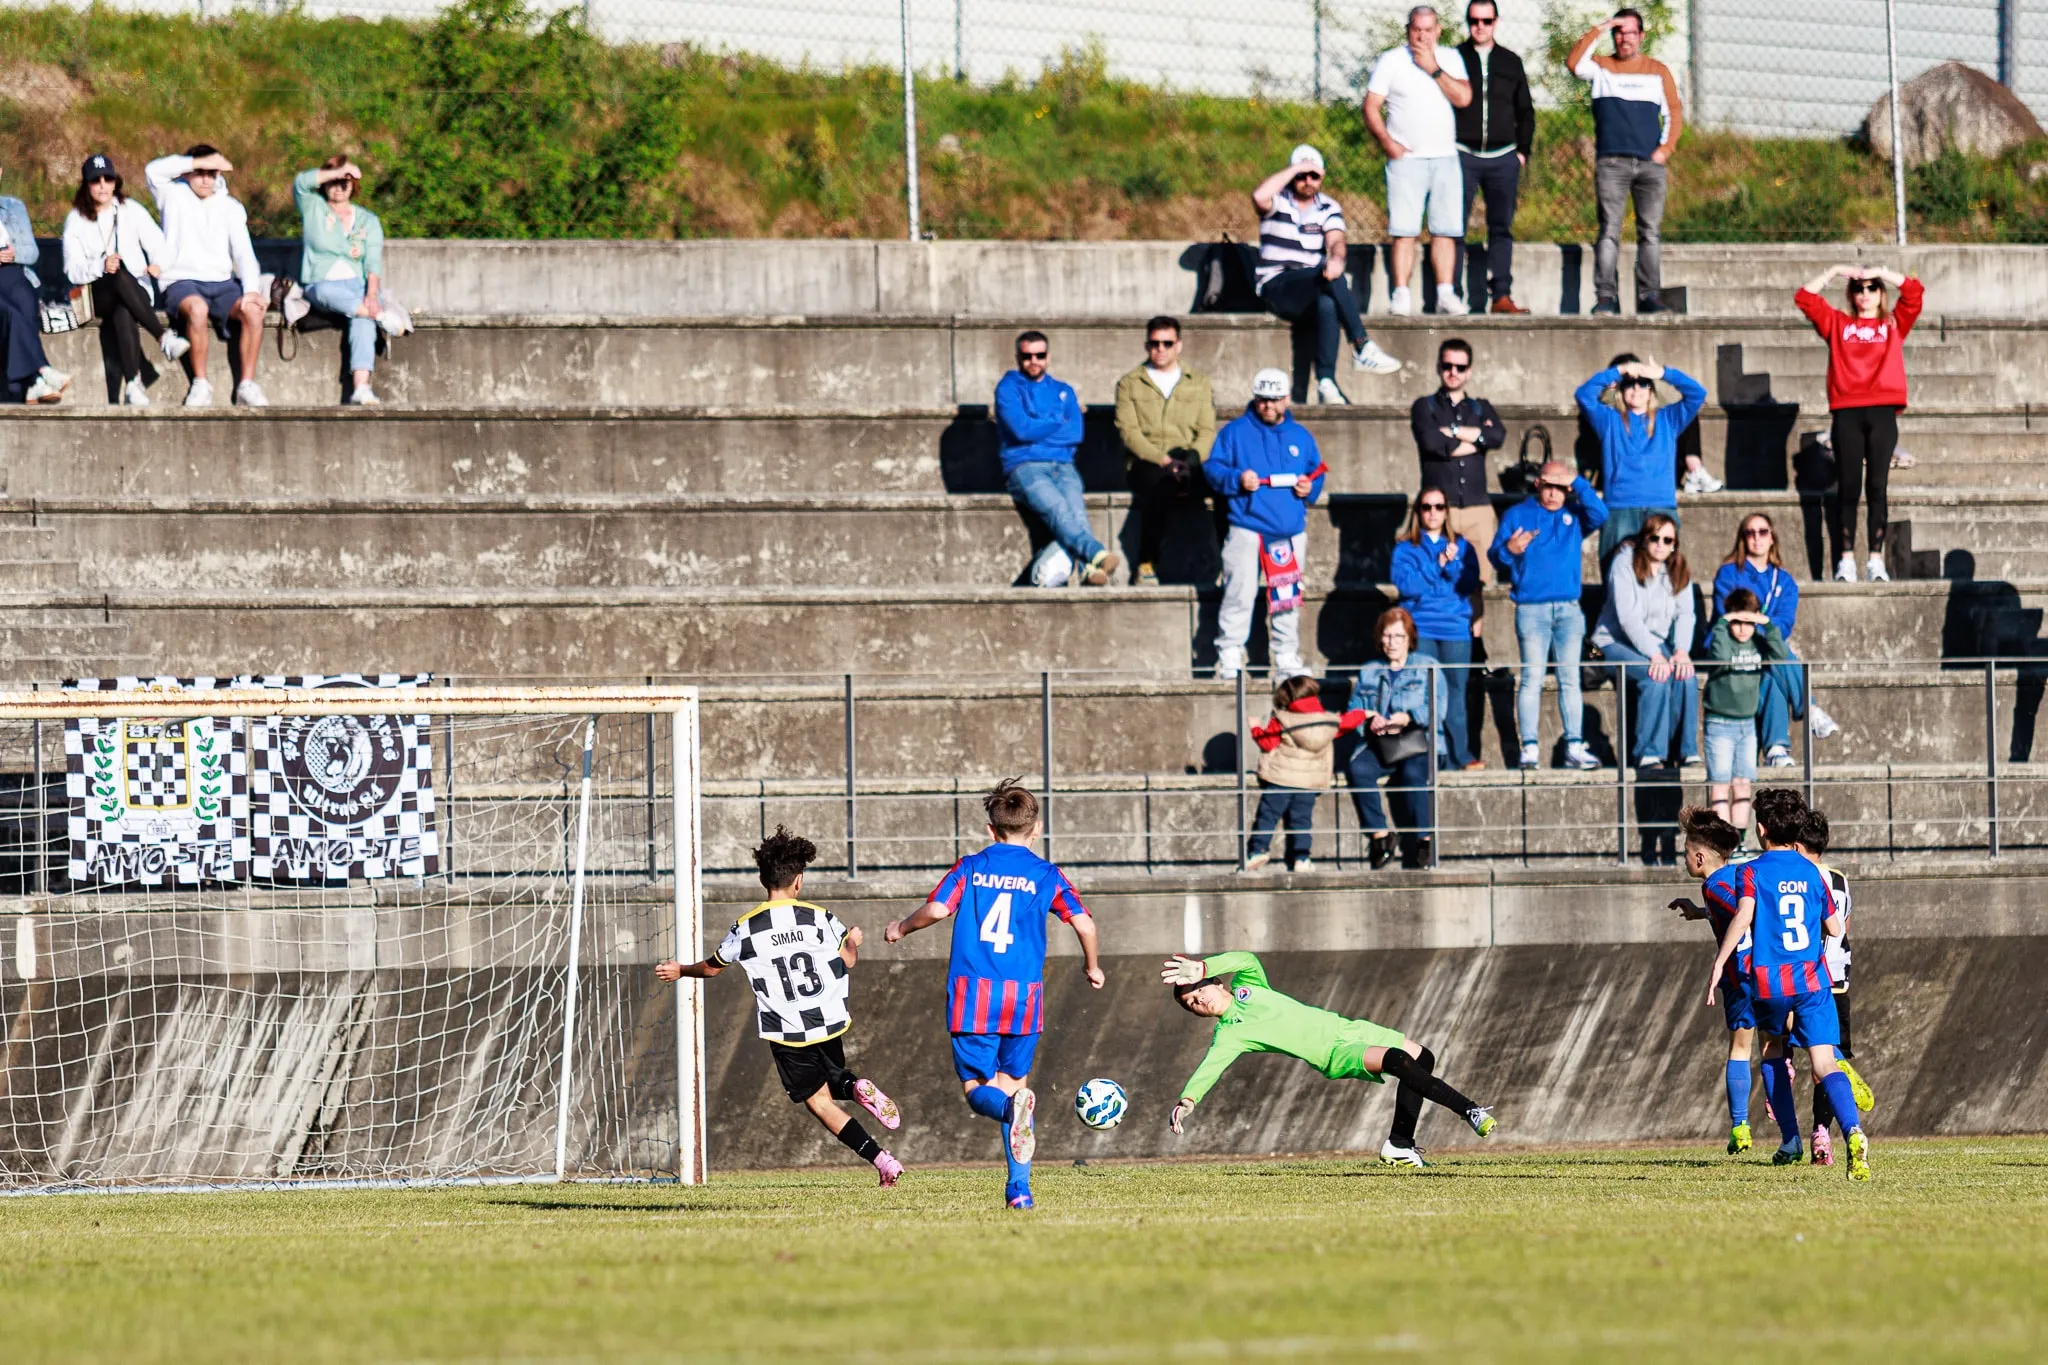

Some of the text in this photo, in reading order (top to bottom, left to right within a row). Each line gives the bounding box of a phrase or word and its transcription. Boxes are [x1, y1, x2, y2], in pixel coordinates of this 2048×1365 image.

[972, 872, 1037, 895] OLIVEIRA
[1777, 880, 1808, 894] GON
[771, 929, 804, 947] SIMÃO
[979, 892, 1014, 954] 4
[1779, 894, 1810, 952] 3
[771, 951, 824, 1003] 13
